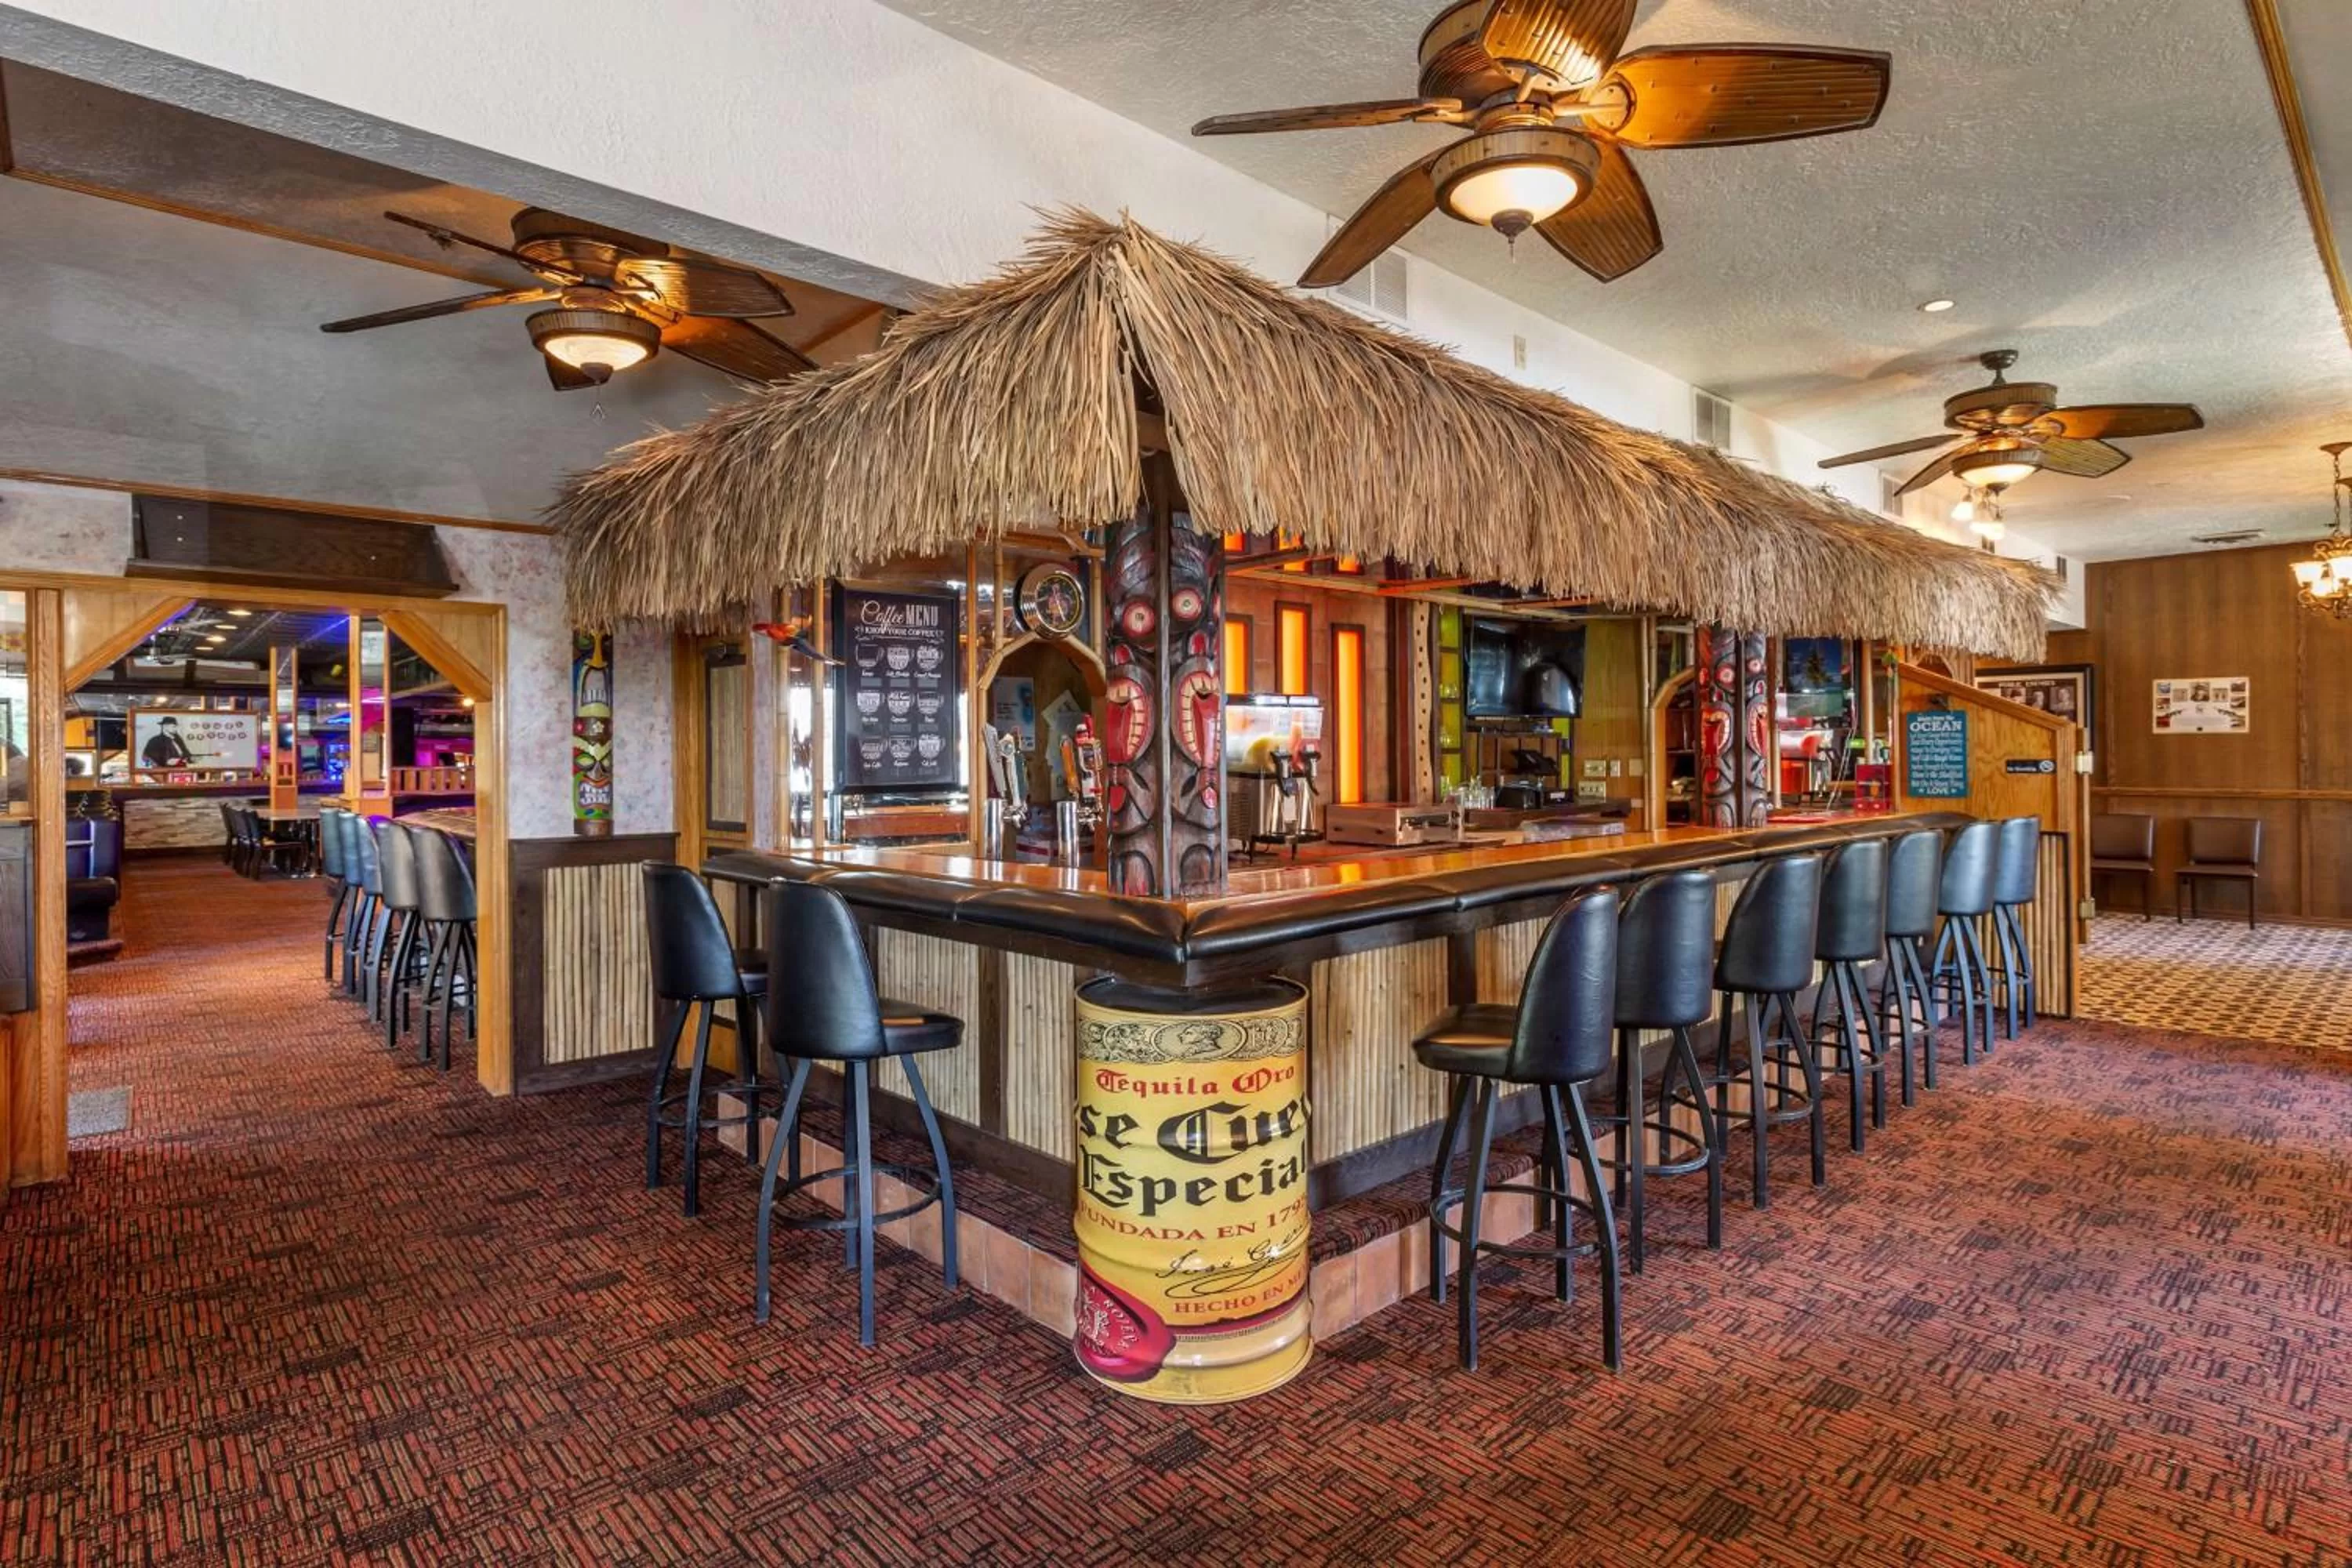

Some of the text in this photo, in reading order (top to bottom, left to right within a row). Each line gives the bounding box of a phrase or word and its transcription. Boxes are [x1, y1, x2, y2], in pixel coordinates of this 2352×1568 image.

[860, 600, 939, 630] Coffee MENU
[1909, 720, 1962, 731] OCEAN
[1095, 1066, 1295, 1098] Tequila Oro
[1074, 1103, 1142, 1150] se
[1079, 1138, 1306, 1217] Especial
[1079, 1201, 1207, 1241] FUNDADA
[1217, 1221, 1258, 1236] EN
[1174, 1295, 1256, 1313] HECHO
[1262, 1283, 1286, 1301] EN
